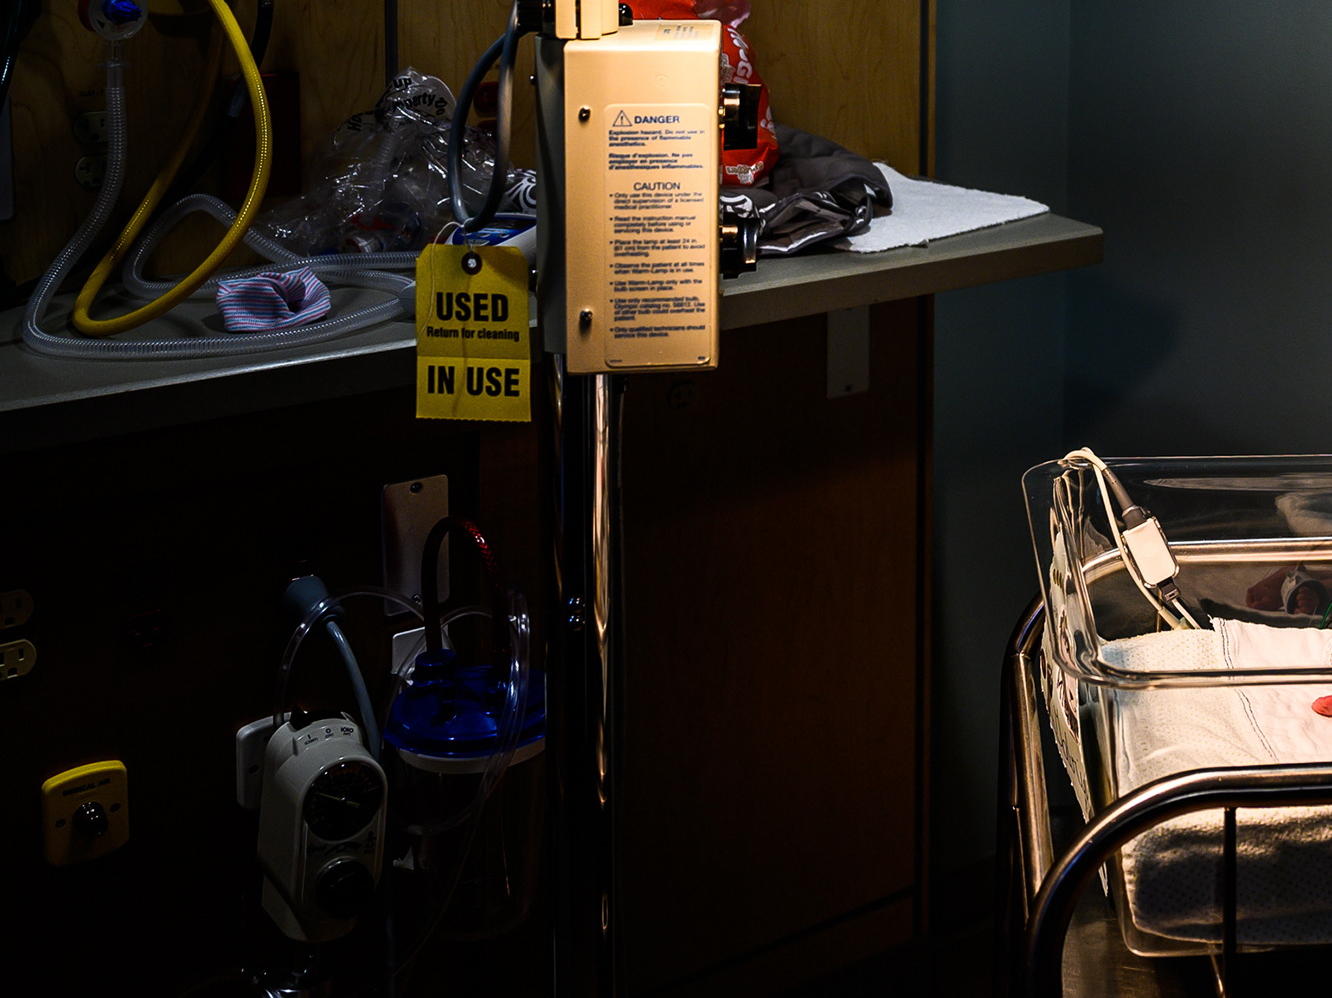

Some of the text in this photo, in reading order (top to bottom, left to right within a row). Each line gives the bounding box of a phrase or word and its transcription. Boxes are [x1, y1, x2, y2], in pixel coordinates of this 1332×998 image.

[634, 116, 680, 124] DANGER
[633, 182, 680, 190] CAUTION
[437, 292, 508, 321] USED
[427, 326, 519, 342] Return for cleaning
[428, 366, 519, 396] IN USE
[63, 778, 110, 796] MEDICAL AIR
